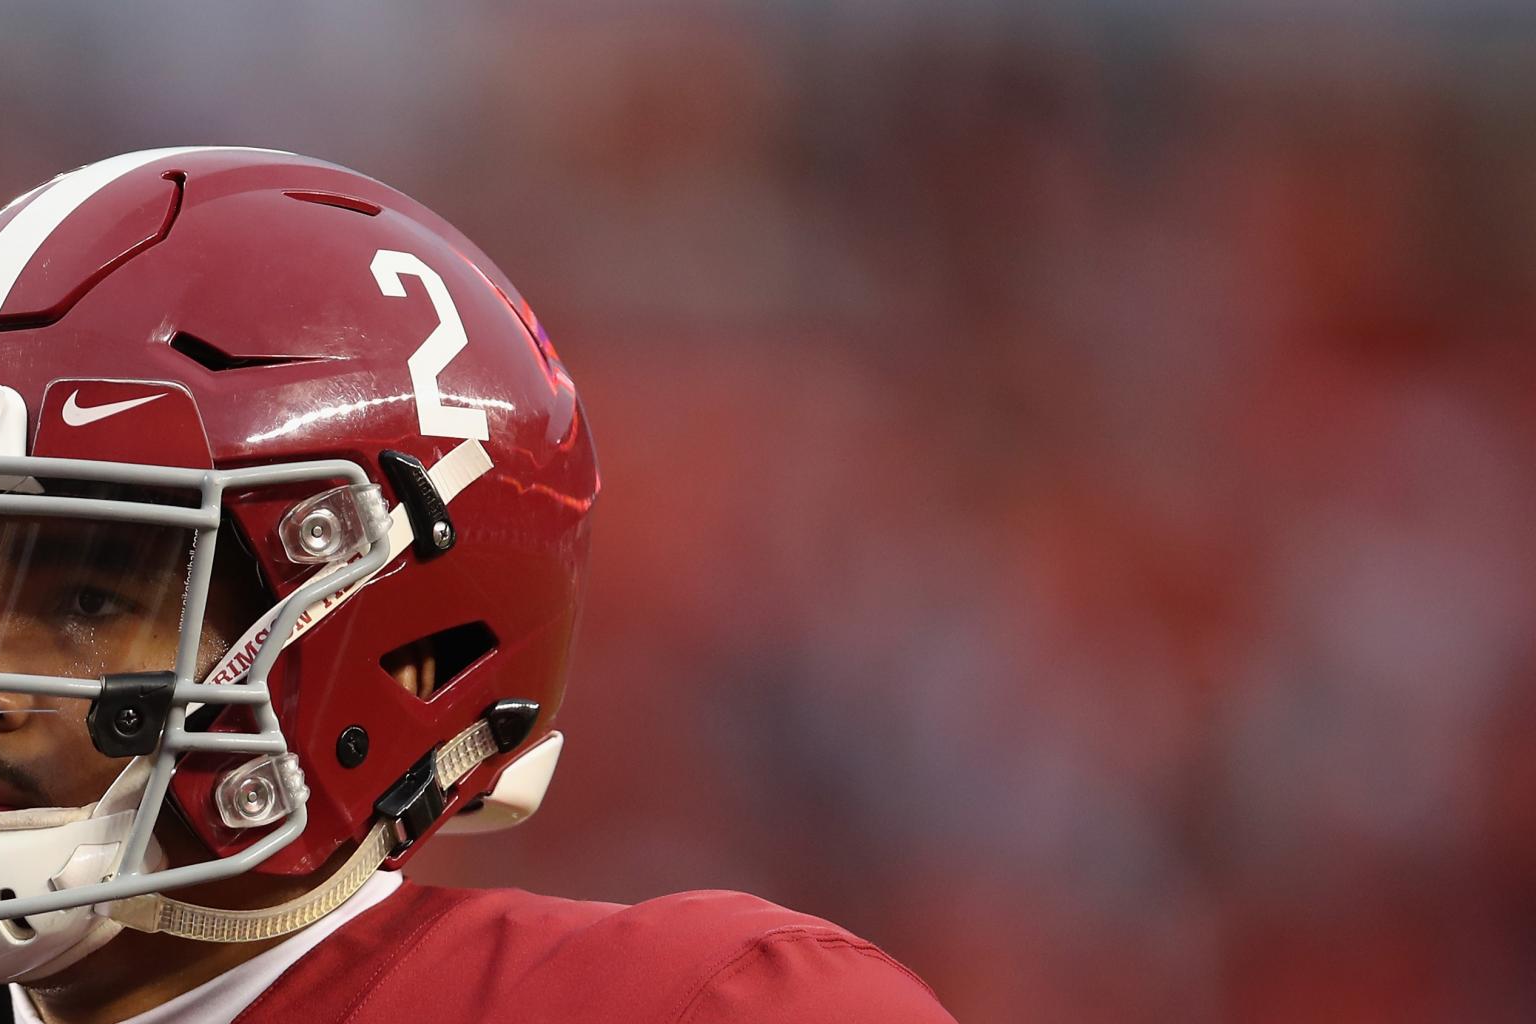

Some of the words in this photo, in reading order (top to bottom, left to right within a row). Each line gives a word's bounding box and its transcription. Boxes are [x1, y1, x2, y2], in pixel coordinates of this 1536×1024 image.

[369, 249, 490, 442] 2
[177, 528, 199, 633] wwwnikefootballcom
[208, 609, 313, 686] RIMSN
